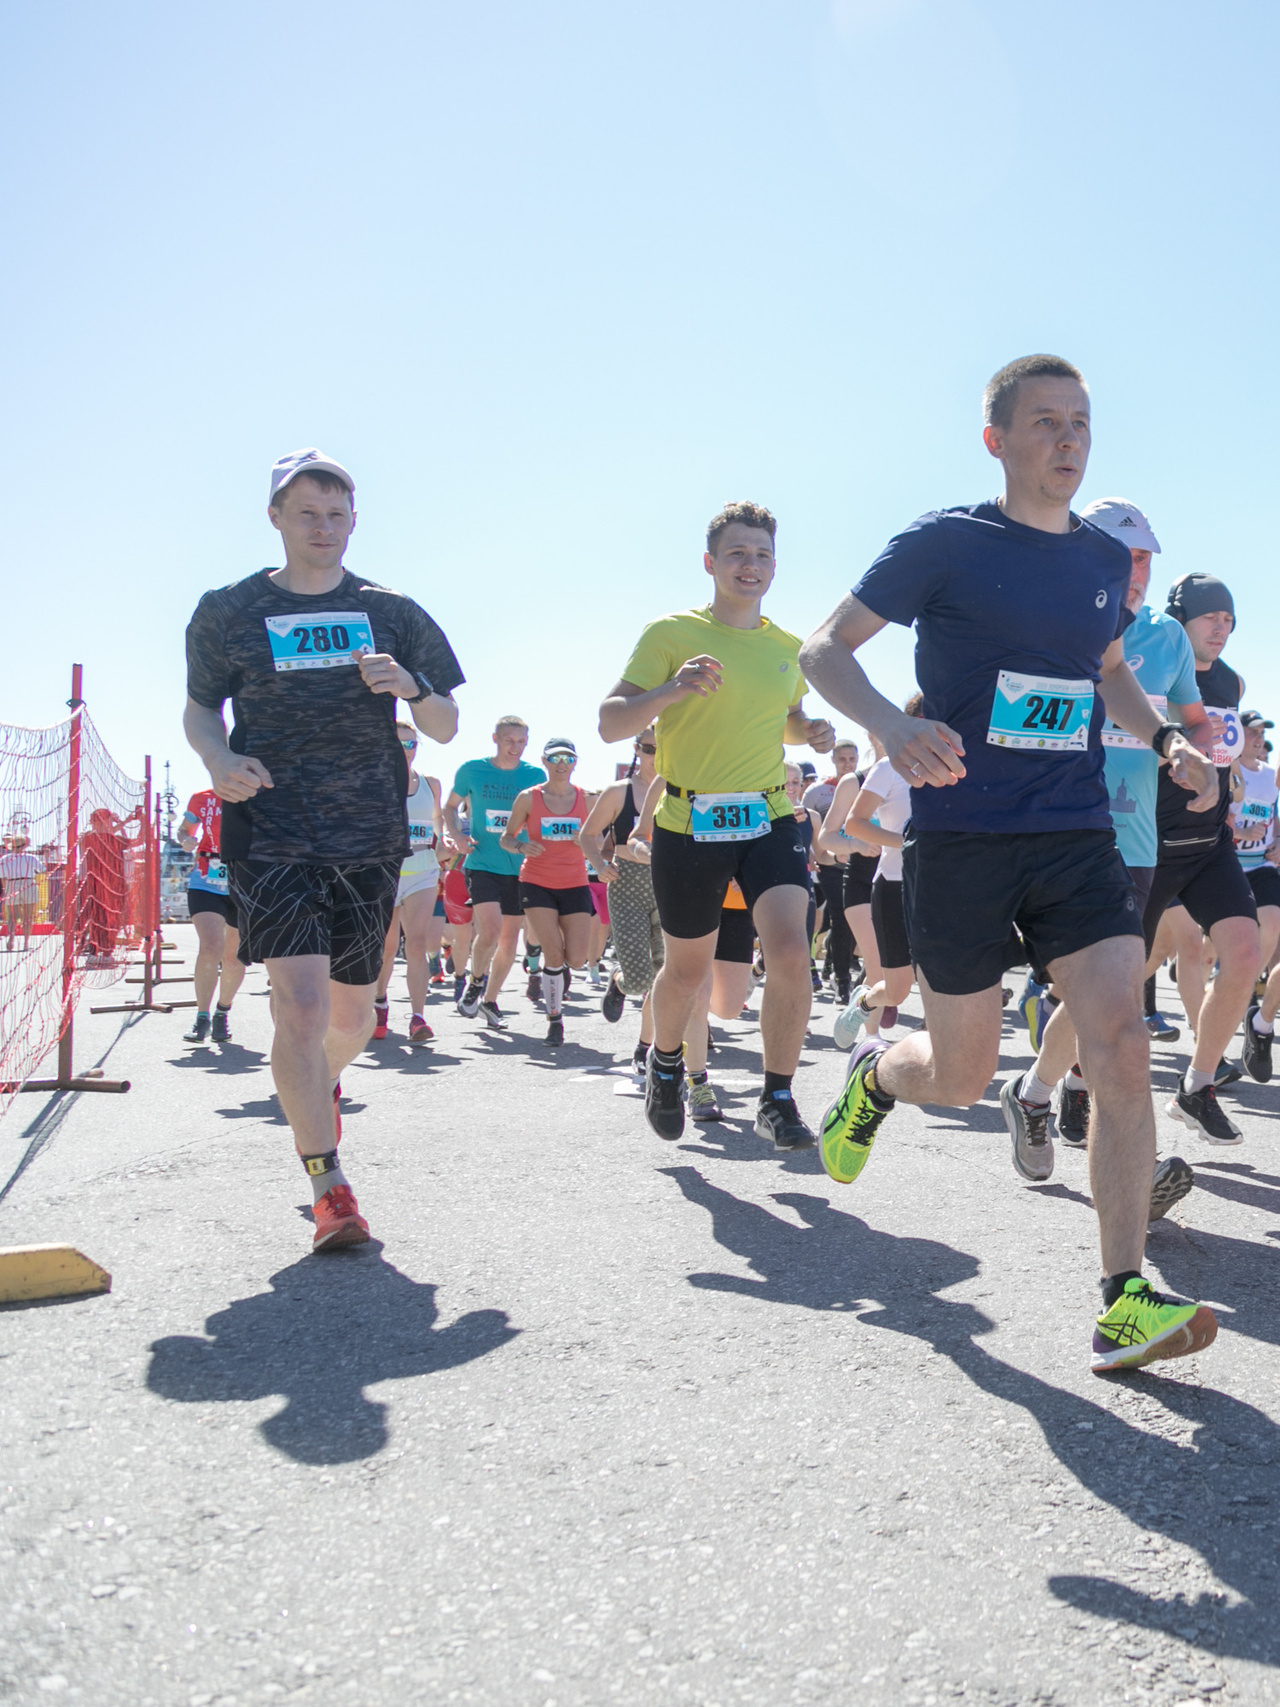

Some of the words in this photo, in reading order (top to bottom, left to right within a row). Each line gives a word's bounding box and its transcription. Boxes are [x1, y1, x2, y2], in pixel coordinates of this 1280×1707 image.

[293, 625, 350, 653] 280
[1022, 695, 1075, 731] 247
[712, 805, 751, 829] 331
[1249, 803, 1266, 818] 305
[552, 823, 573, 835] 341
